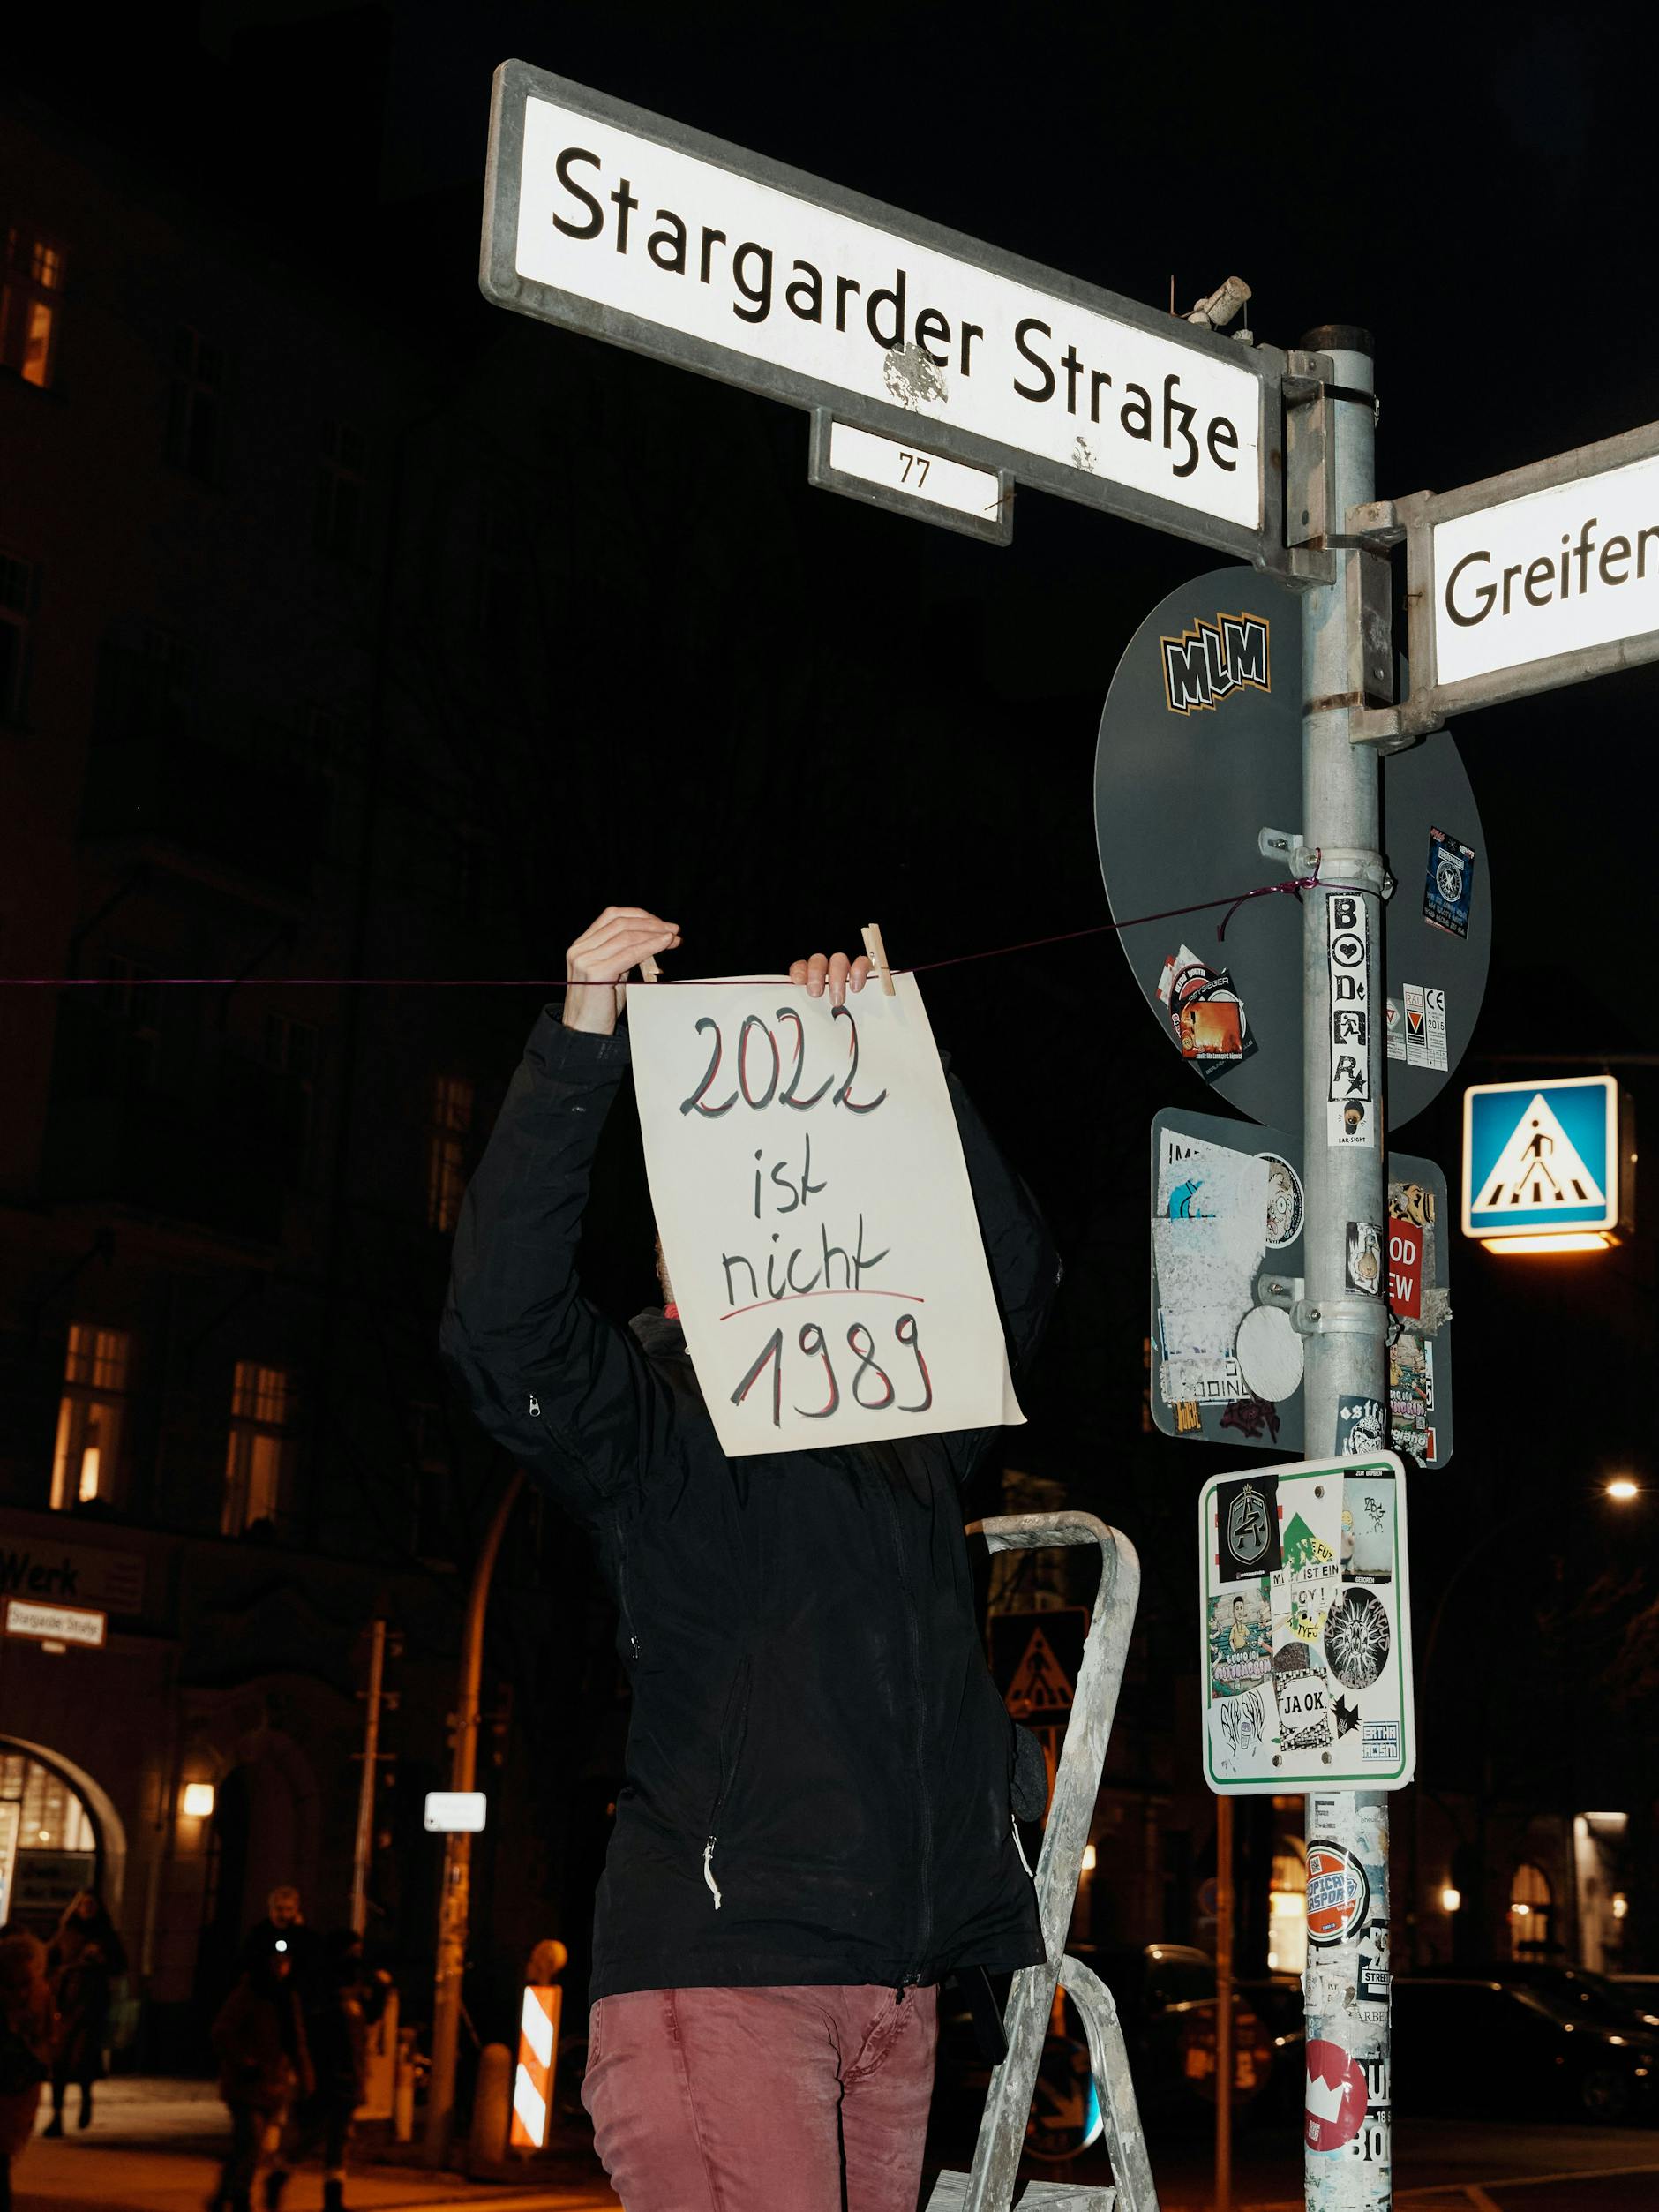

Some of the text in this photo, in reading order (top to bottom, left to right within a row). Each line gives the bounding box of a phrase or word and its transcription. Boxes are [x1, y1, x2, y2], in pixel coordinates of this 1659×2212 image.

[552, 147, 1239, 478] Stargarder Straße
[898, 451, 931, 489] 77
[1164, 617, 1268, 712] MLM
[679, 1005, 890, 1119] 2022
[1428, 1019, 1445, 1031] 2015
[753, 1132, 828, 1219] ist
[722, 1212, 890, 1306] nicht
[730, 1313, 934, 1428] 1989
[1303, 1568, 1318, 1580] IST
[1322, 1564, 1339, 1576] EIN
[1284, 1695, 1302, 1714] JA
